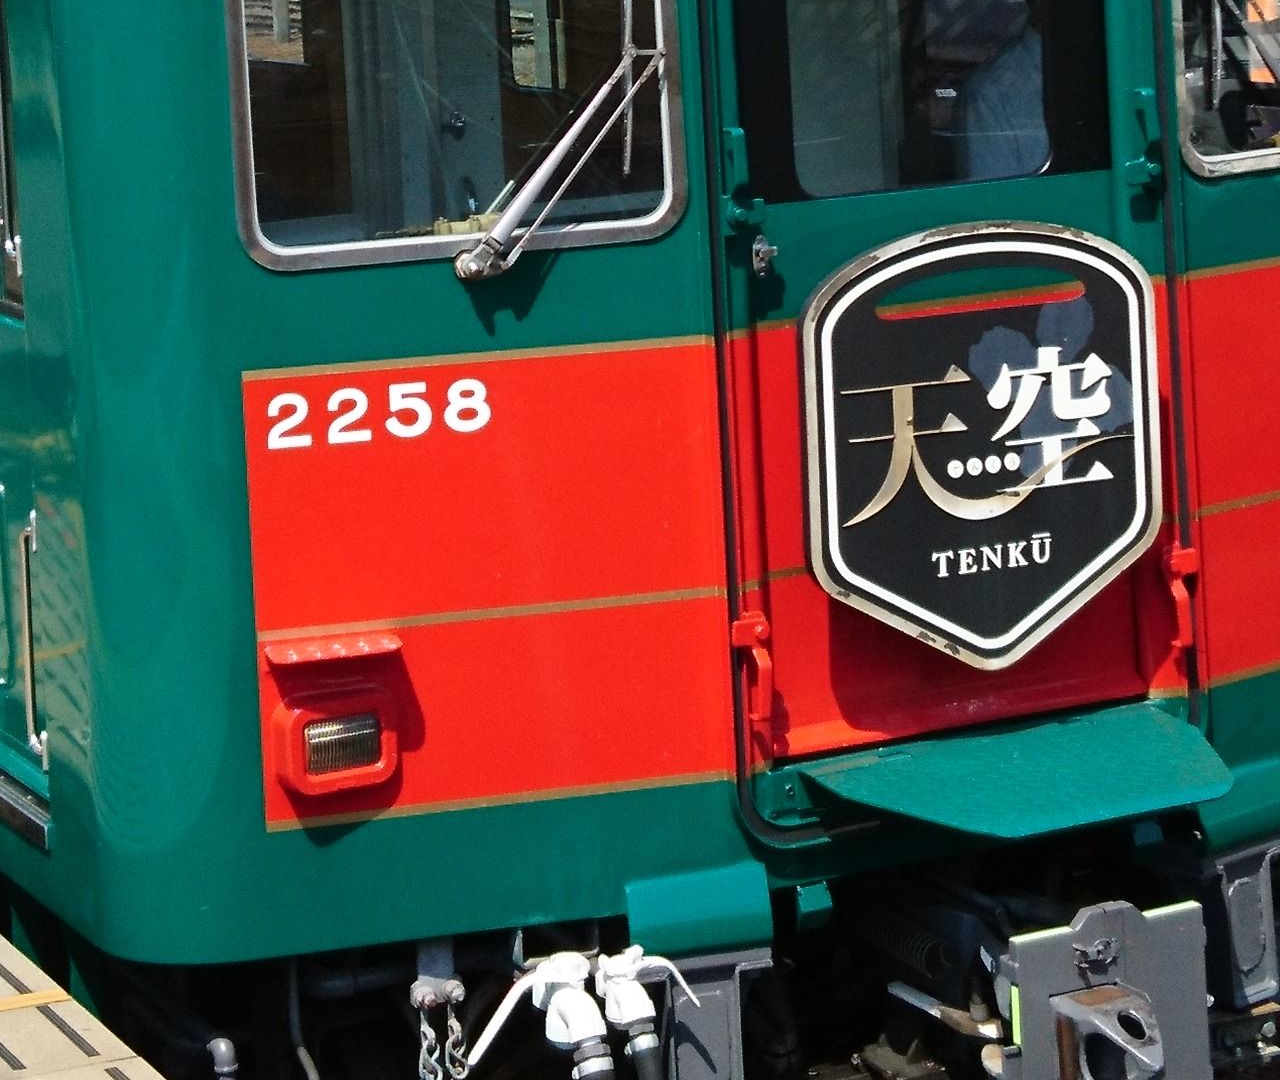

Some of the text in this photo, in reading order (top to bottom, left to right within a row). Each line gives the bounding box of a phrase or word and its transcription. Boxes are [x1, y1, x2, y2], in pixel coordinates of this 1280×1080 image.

[267, 378, 492, 450] 2258
[840, 345, 1134, 528] 天空
[932, 532, 1052, 578] TENKŪ
